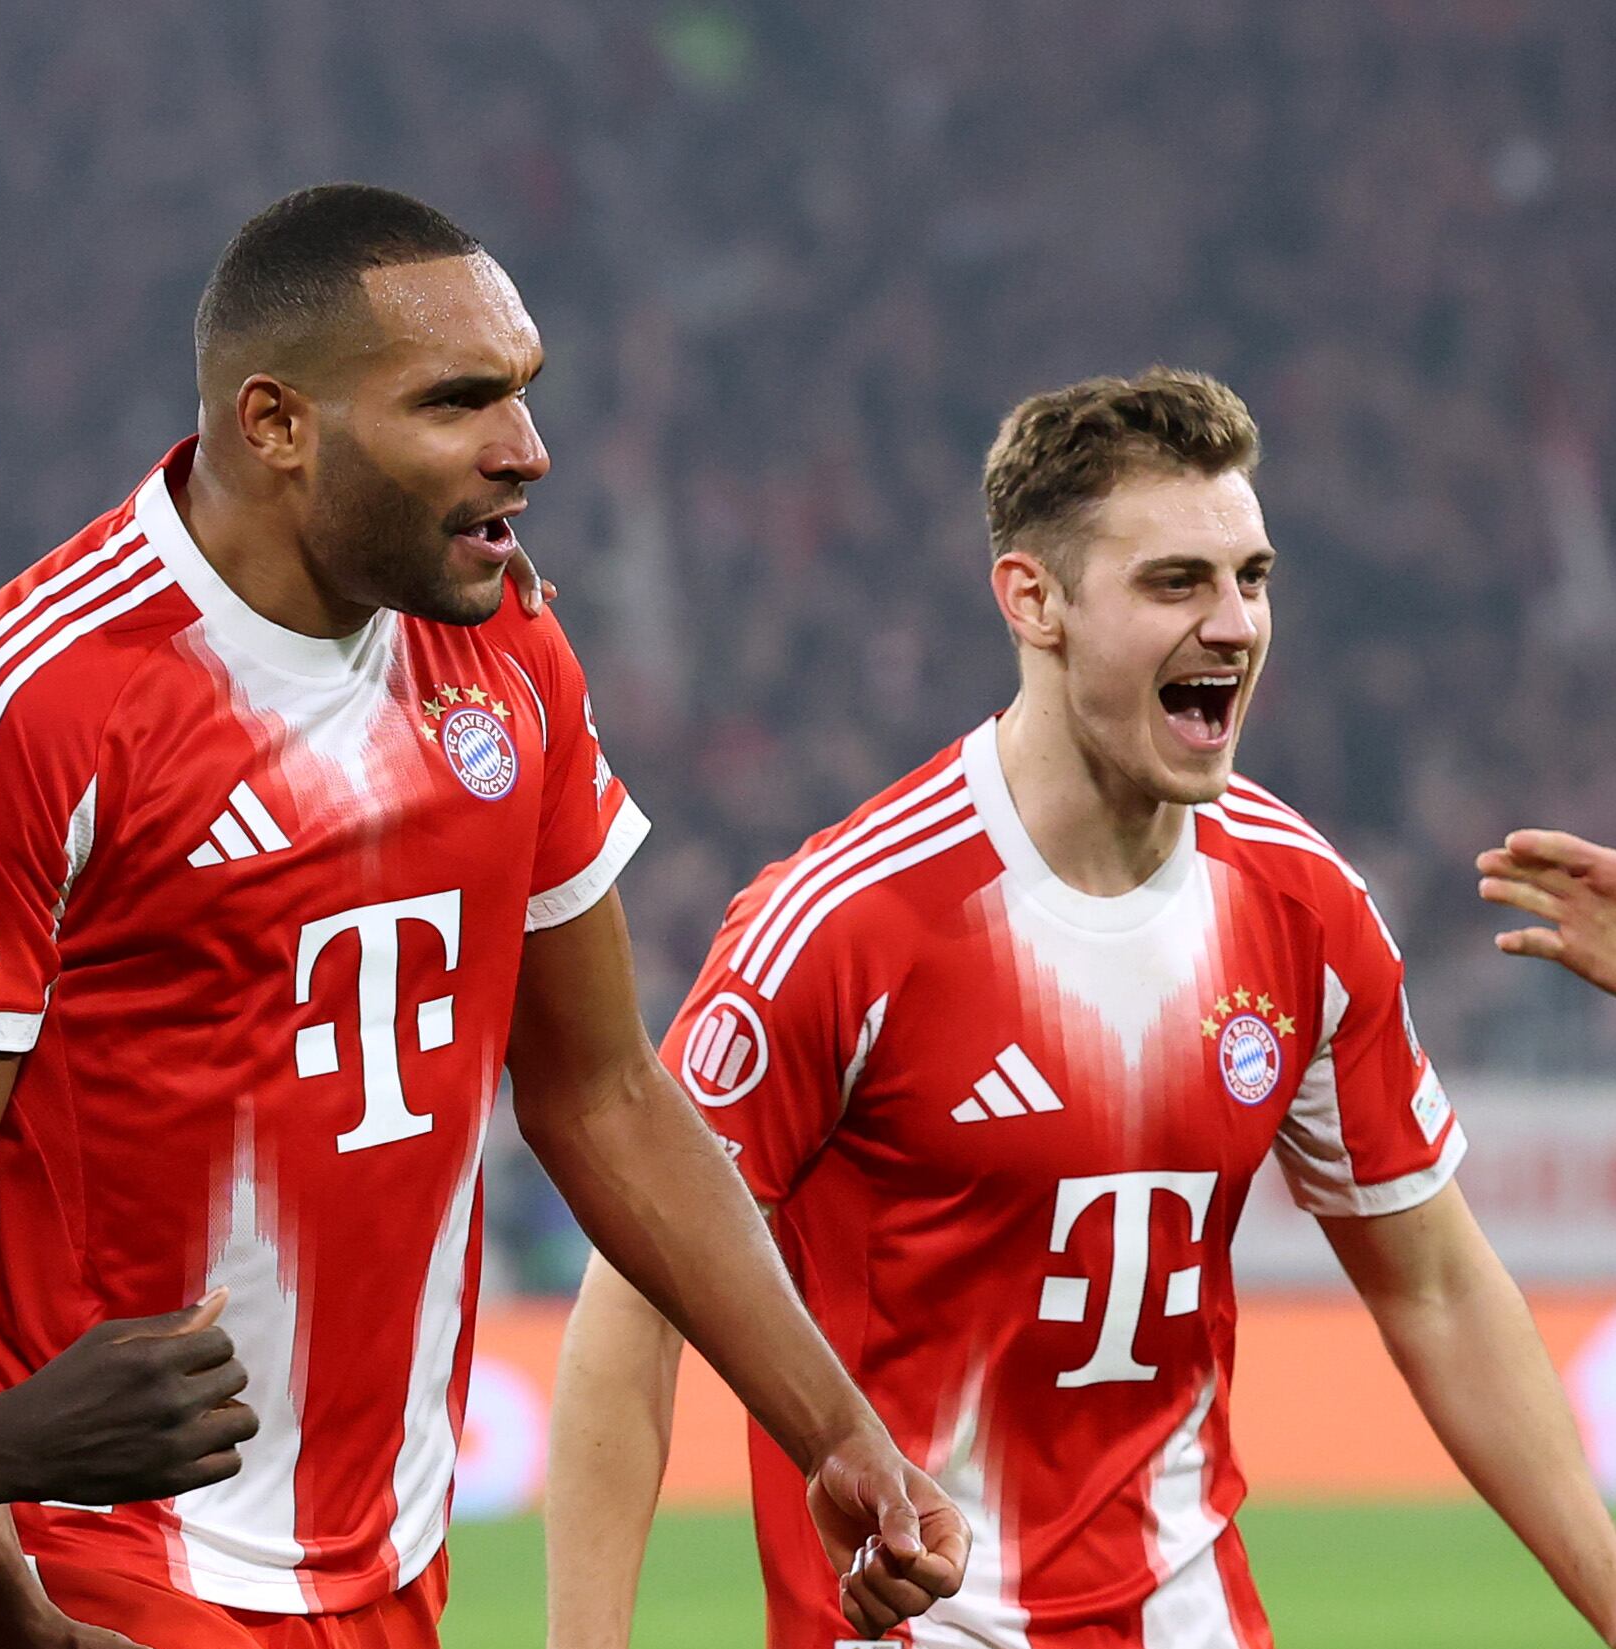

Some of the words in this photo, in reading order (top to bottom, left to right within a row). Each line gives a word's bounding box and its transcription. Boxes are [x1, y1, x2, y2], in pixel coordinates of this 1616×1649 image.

[452, 714, 502, 742] BAYERN
[295, 889, 462, 1154] T
[1038, 1170, 1217, 1388] T
